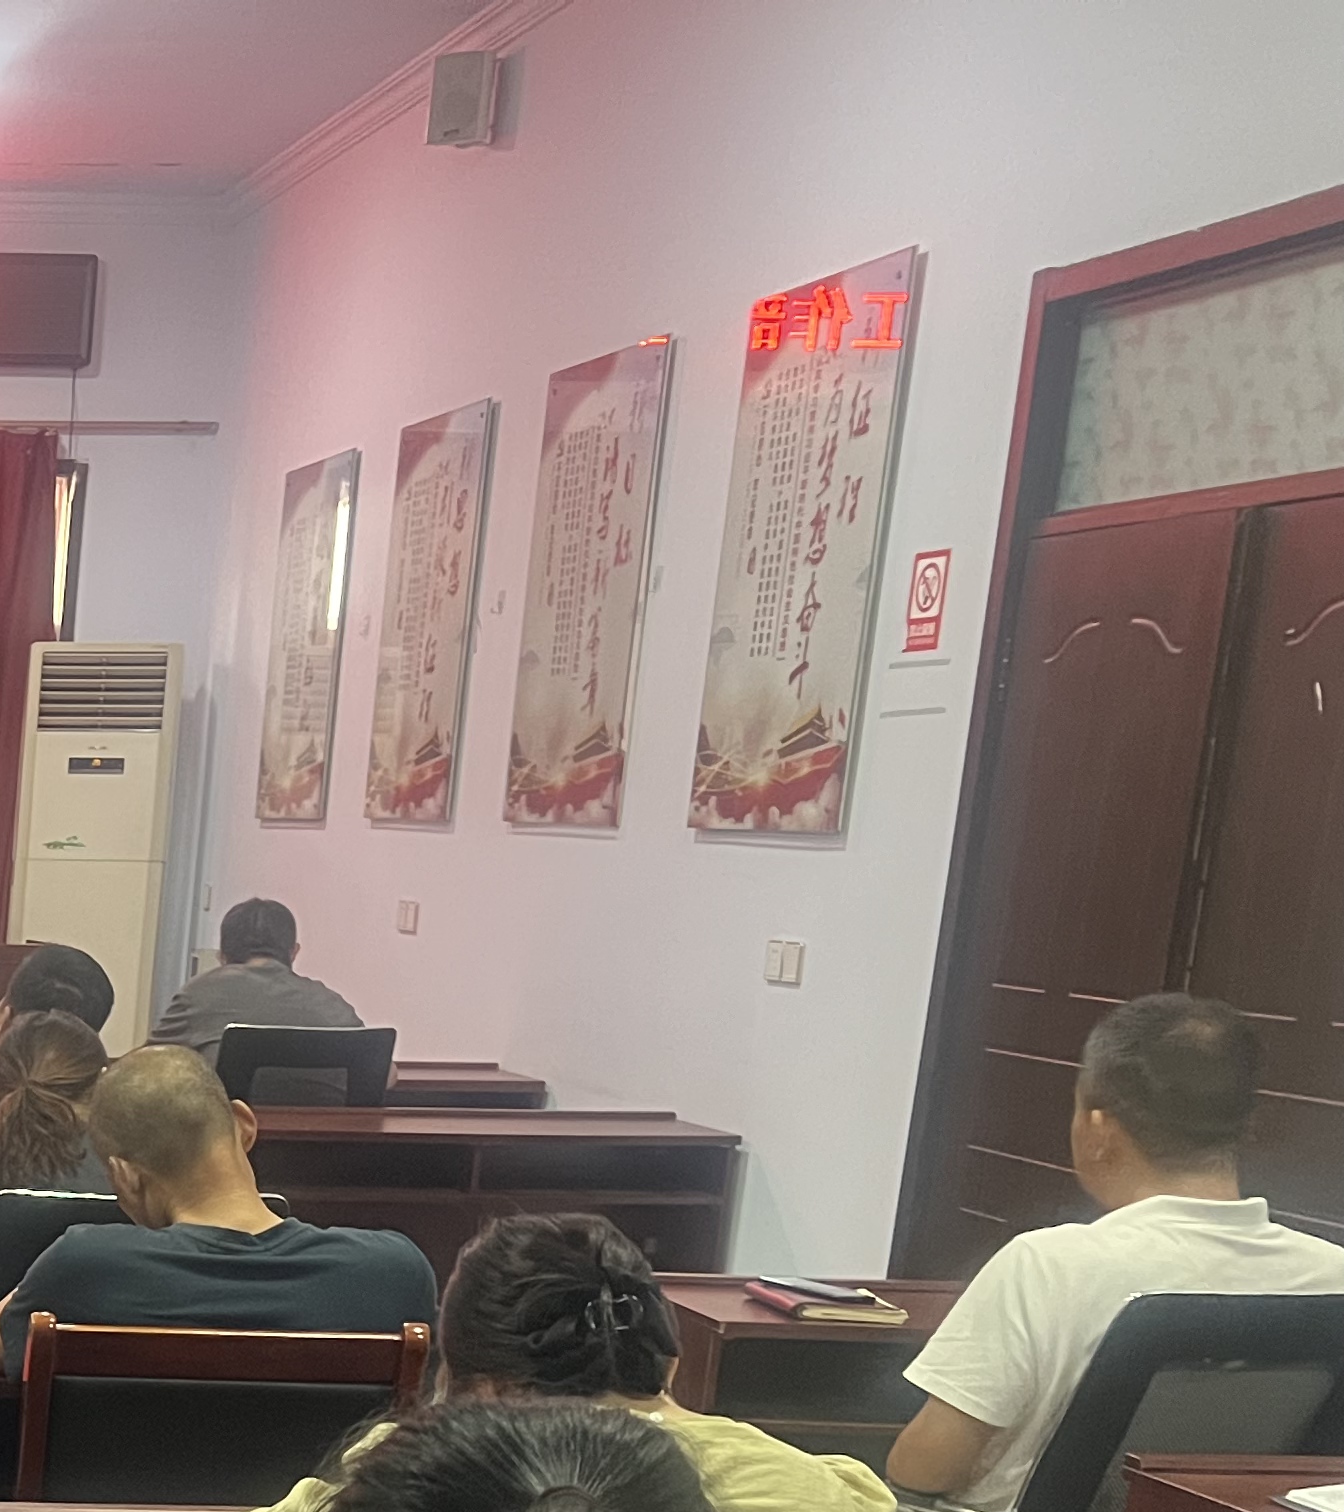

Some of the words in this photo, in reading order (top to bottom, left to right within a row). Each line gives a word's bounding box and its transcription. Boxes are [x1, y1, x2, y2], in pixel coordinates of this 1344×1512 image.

[788, 372, 845, 699] 为梦想奋斗
